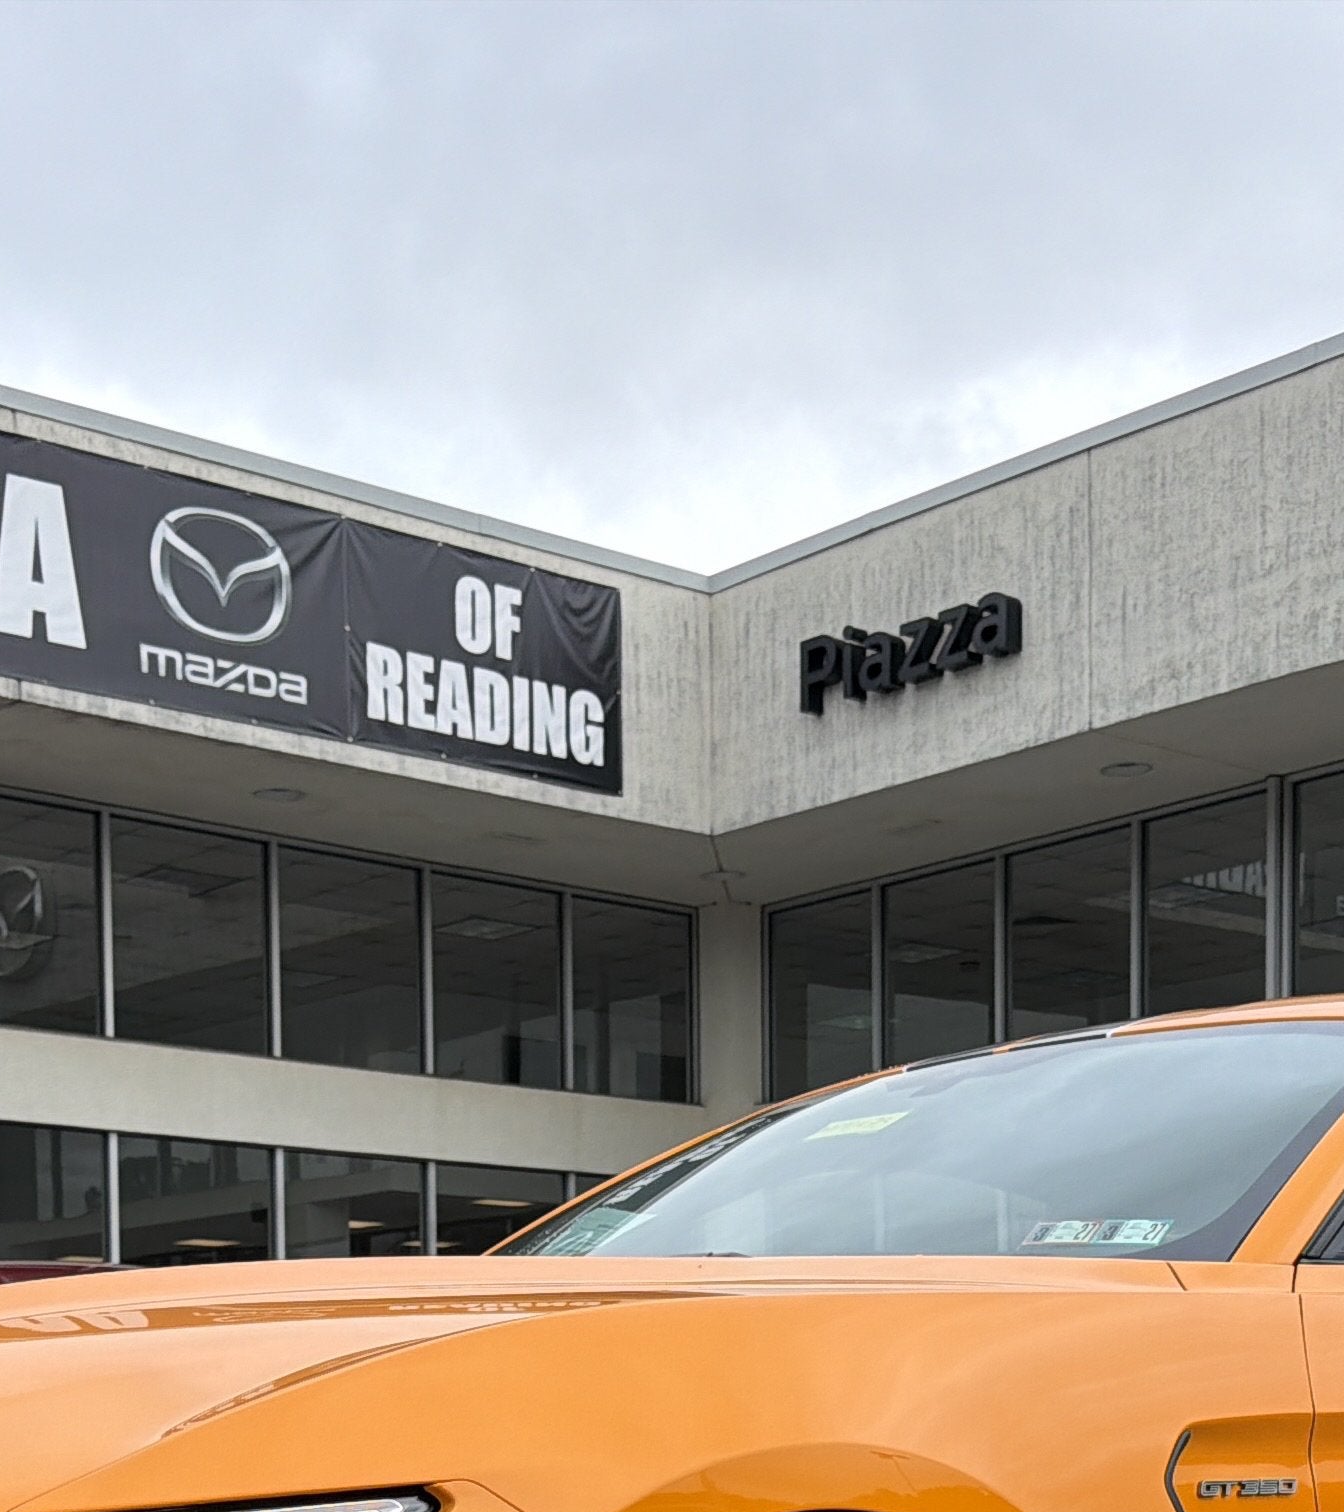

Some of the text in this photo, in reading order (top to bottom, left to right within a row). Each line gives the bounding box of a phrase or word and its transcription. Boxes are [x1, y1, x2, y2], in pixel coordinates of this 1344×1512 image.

[454, 574, 523, 660] OF
[800, 592, 1023, 716] Piazza
[139, 642, 308, 705] mazda
[365, 641, 605, 767] READING
[1197, 1478, 1299, 1499] GT350
